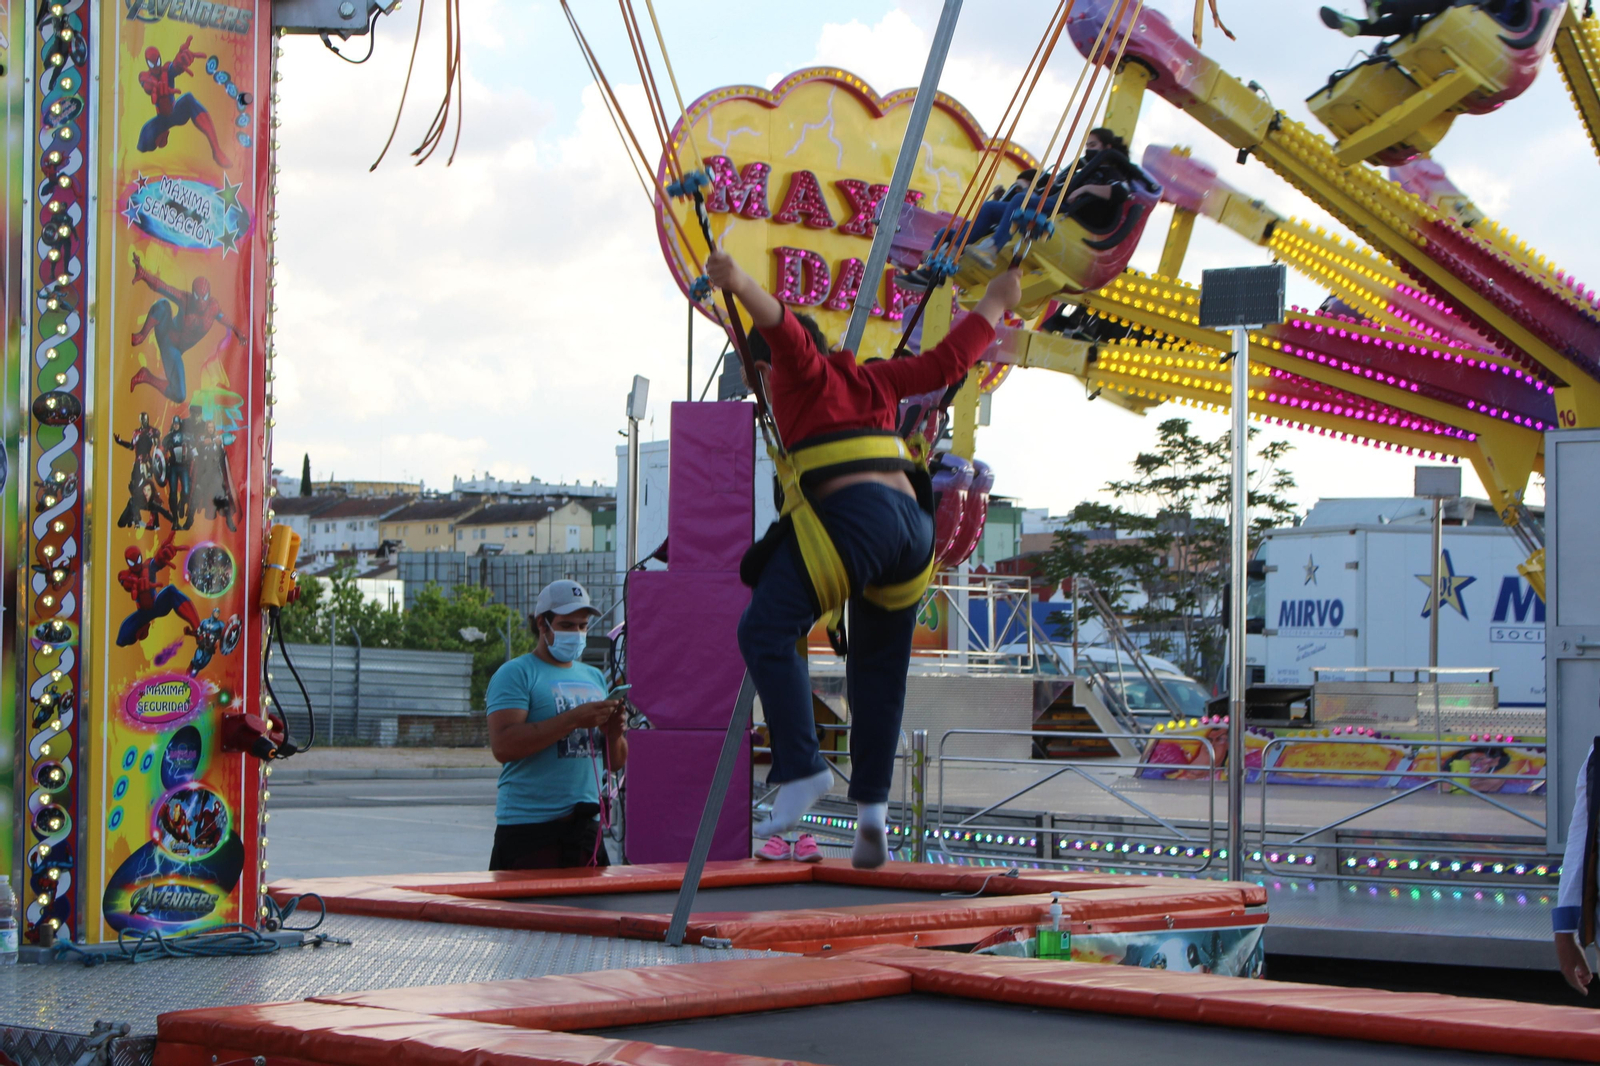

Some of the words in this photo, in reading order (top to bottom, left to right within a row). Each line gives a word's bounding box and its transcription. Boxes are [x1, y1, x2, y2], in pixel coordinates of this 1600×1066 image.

[160, 175, 212, 219] MÁXIMA
[702, 155, 926, 239] MAX
[143, 196, 214, 247] SENSACIÓN
[1559, 409, 1577, 427] 10
[1278, 598, 1344, 628] MIRVO
[145, 682, 184, 696] MÁXIMA
[137, 701, 190, 712] SEGURIDAD
